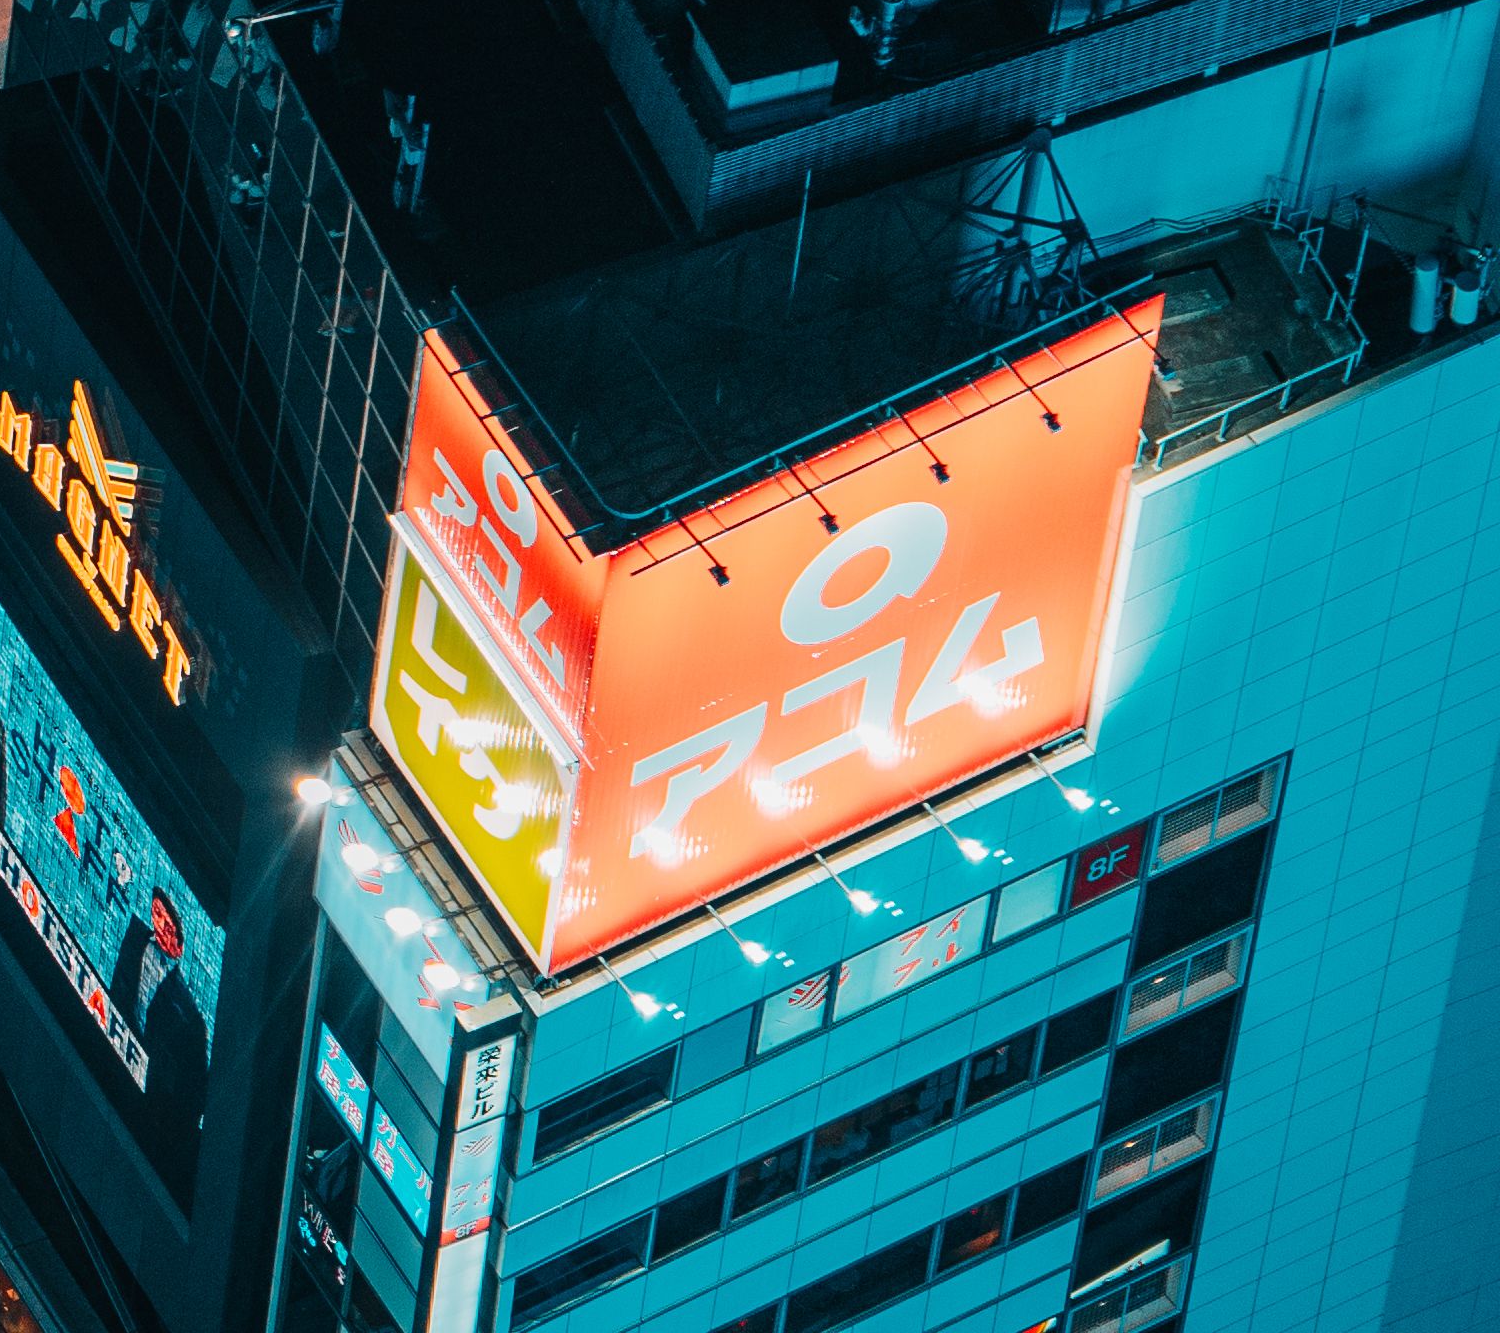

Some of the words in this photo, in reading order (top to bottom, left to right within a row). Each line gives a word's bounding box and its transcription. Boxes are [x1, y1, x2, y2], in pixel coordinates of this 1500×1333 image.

[429, 446, 566, 691] アコム
[398, 577, 524, 840] レイク
[631, 590, 1046, 860] アコム
[1086, 844, 1129, 884] 8F
